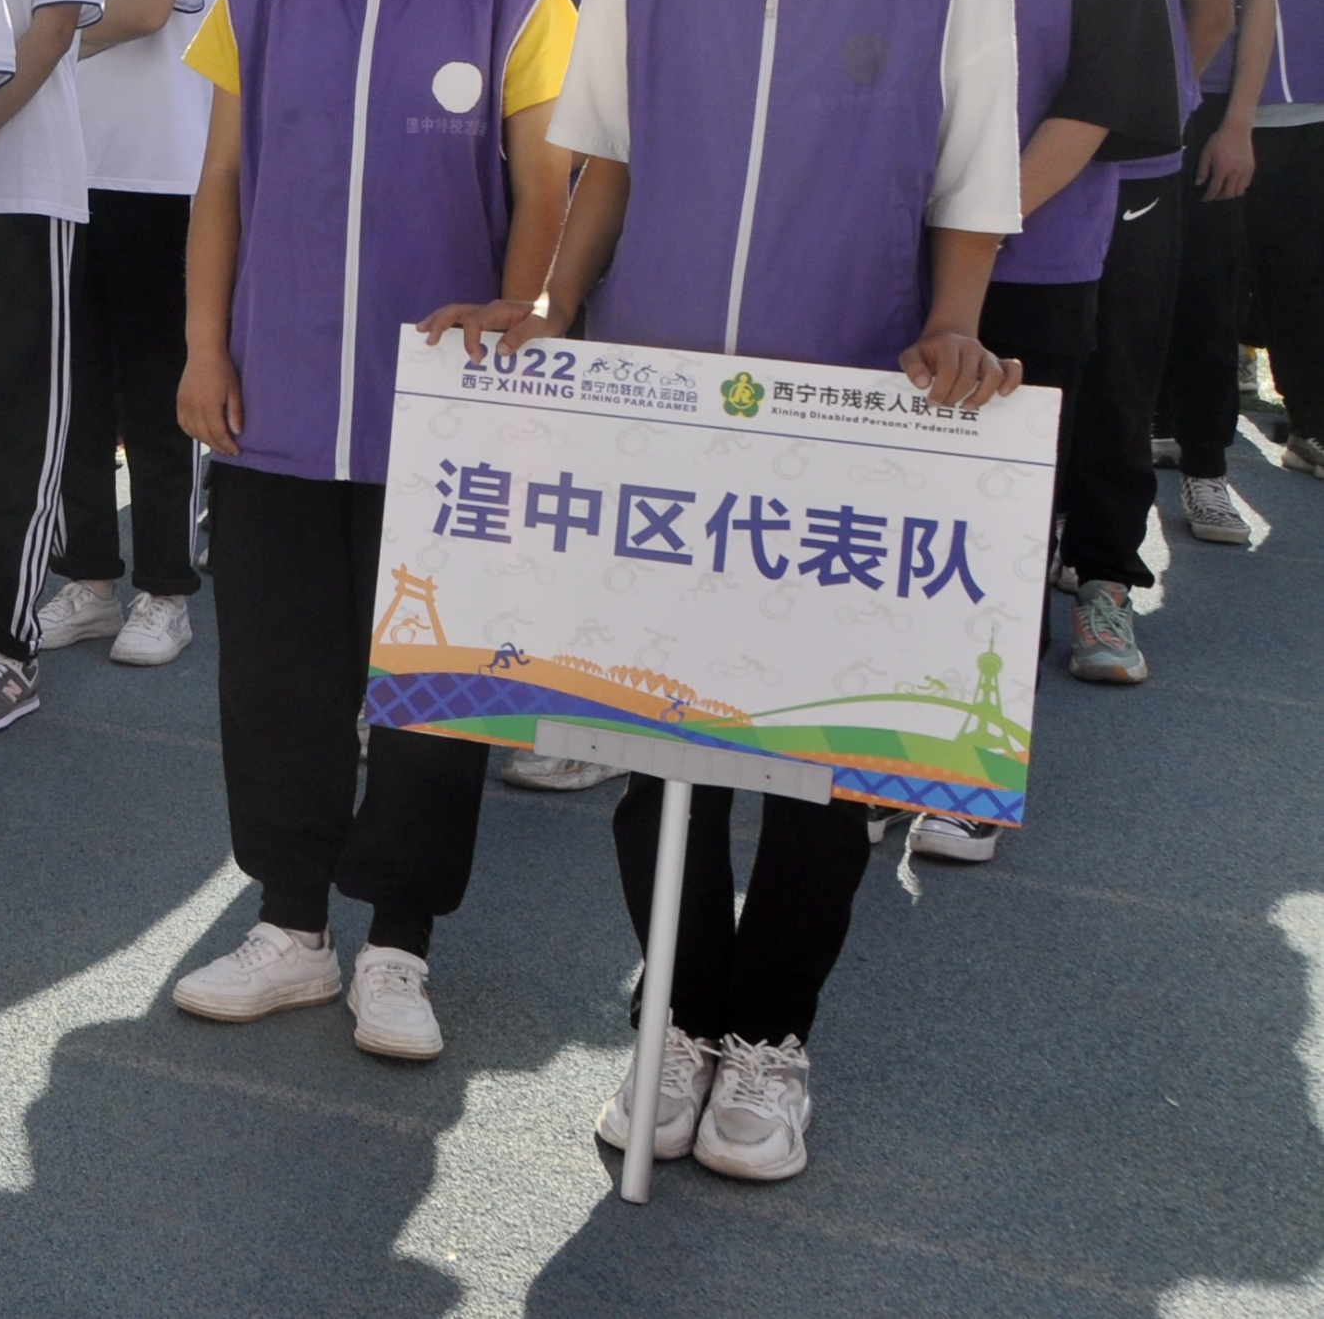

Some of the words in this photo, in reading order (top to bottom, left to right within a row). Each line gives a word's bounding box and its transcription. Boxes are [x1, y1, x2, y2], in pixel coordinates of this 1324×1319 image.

[463, 342, 576, 382] 2022
[580, 379, 698, 404] 西宁市残疾人运动会
[580, 393, 620, 404] XINING
[623, 397, 654, 408] PARA
[657, 401, 697, 413] GAMES
[771, 406, 806, 419] Xining
[809, 410, 859, 424] Disabled
[862, 416, 912, 429] Persons'
[915, 422, 978, 436] Federation
[432, 458, 986, 605] 湟中区代表队
